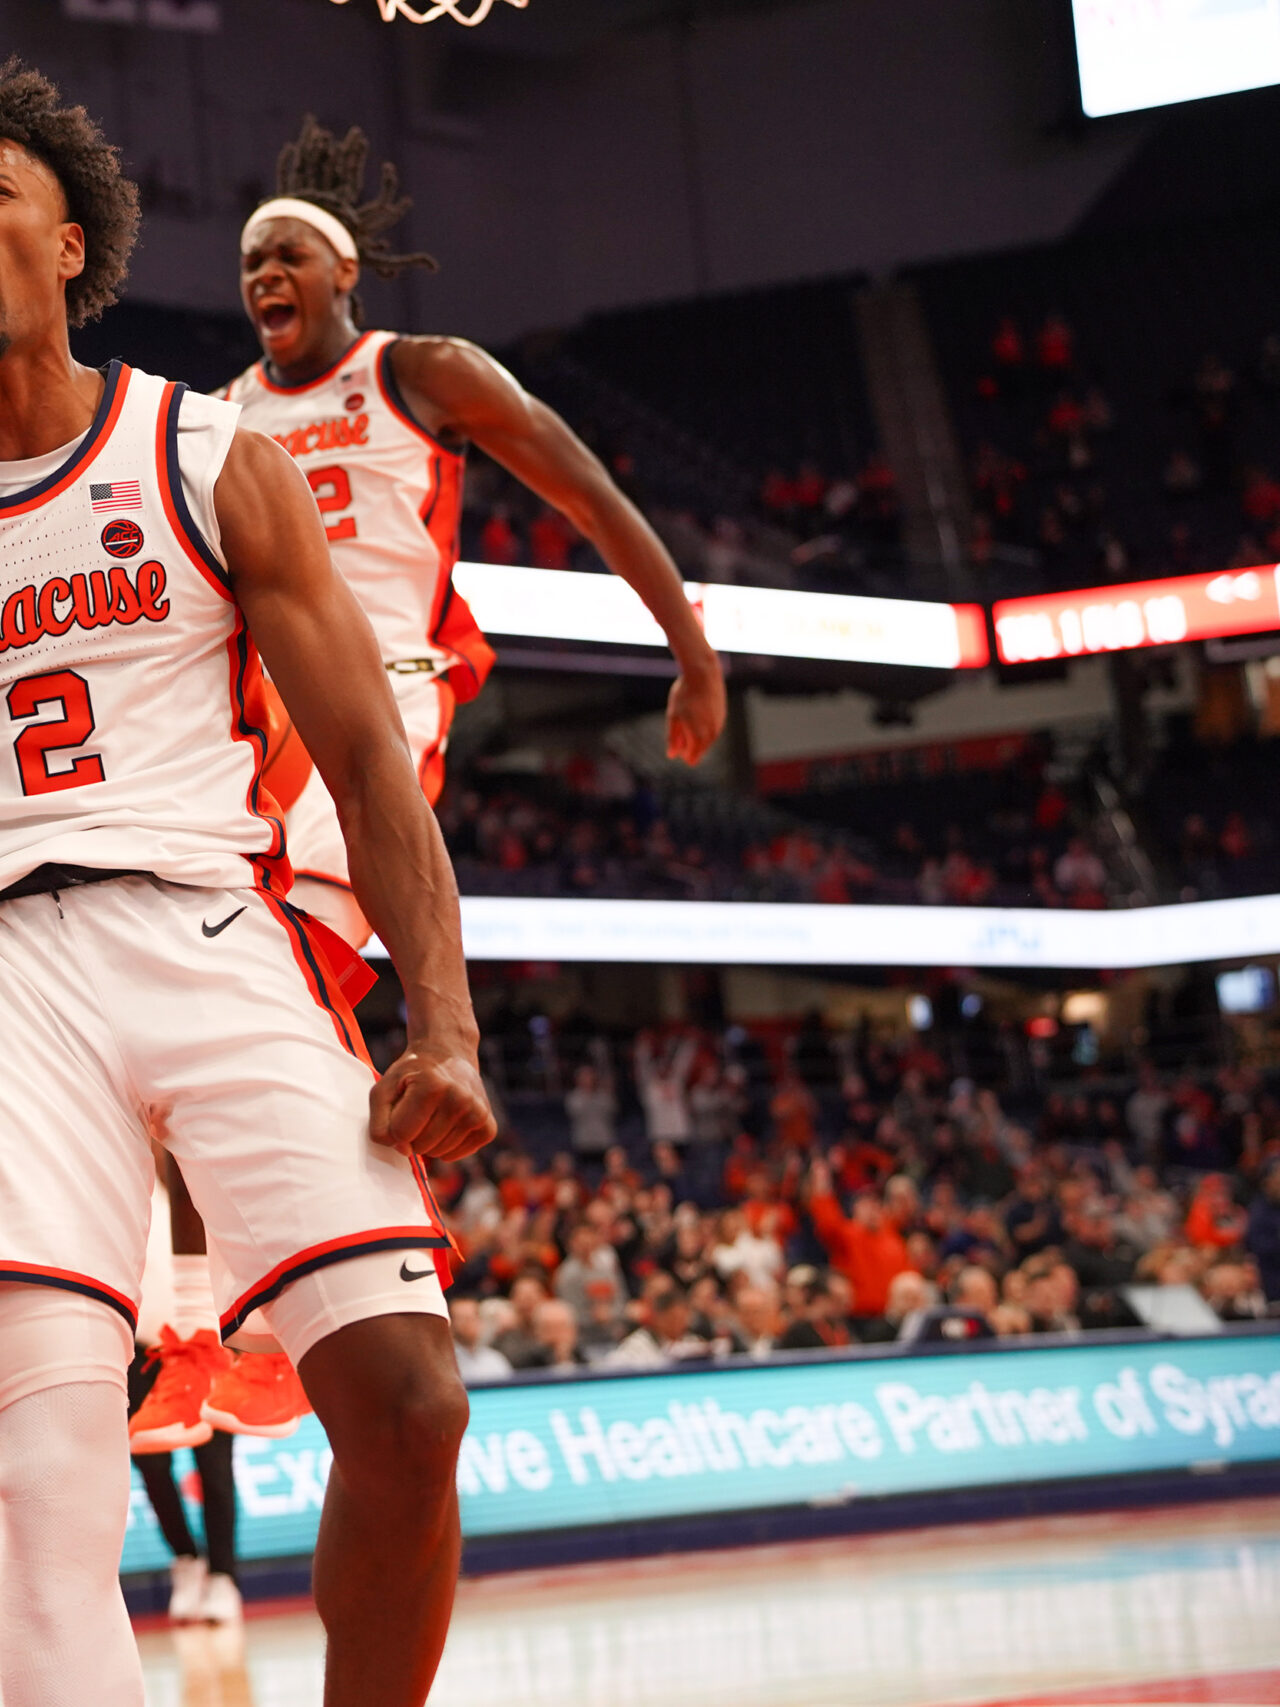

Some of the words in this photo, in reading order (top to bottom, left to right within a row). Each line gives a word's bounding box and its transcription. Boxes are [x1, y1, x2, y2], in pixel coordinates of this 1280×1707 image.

[5, 668, 106, 796] 2
[549, 1397, 882, 1484] Healthcare
[874, 1381, 1089, 1456] Partner
[1093, 1367, 1158, 1439] of
